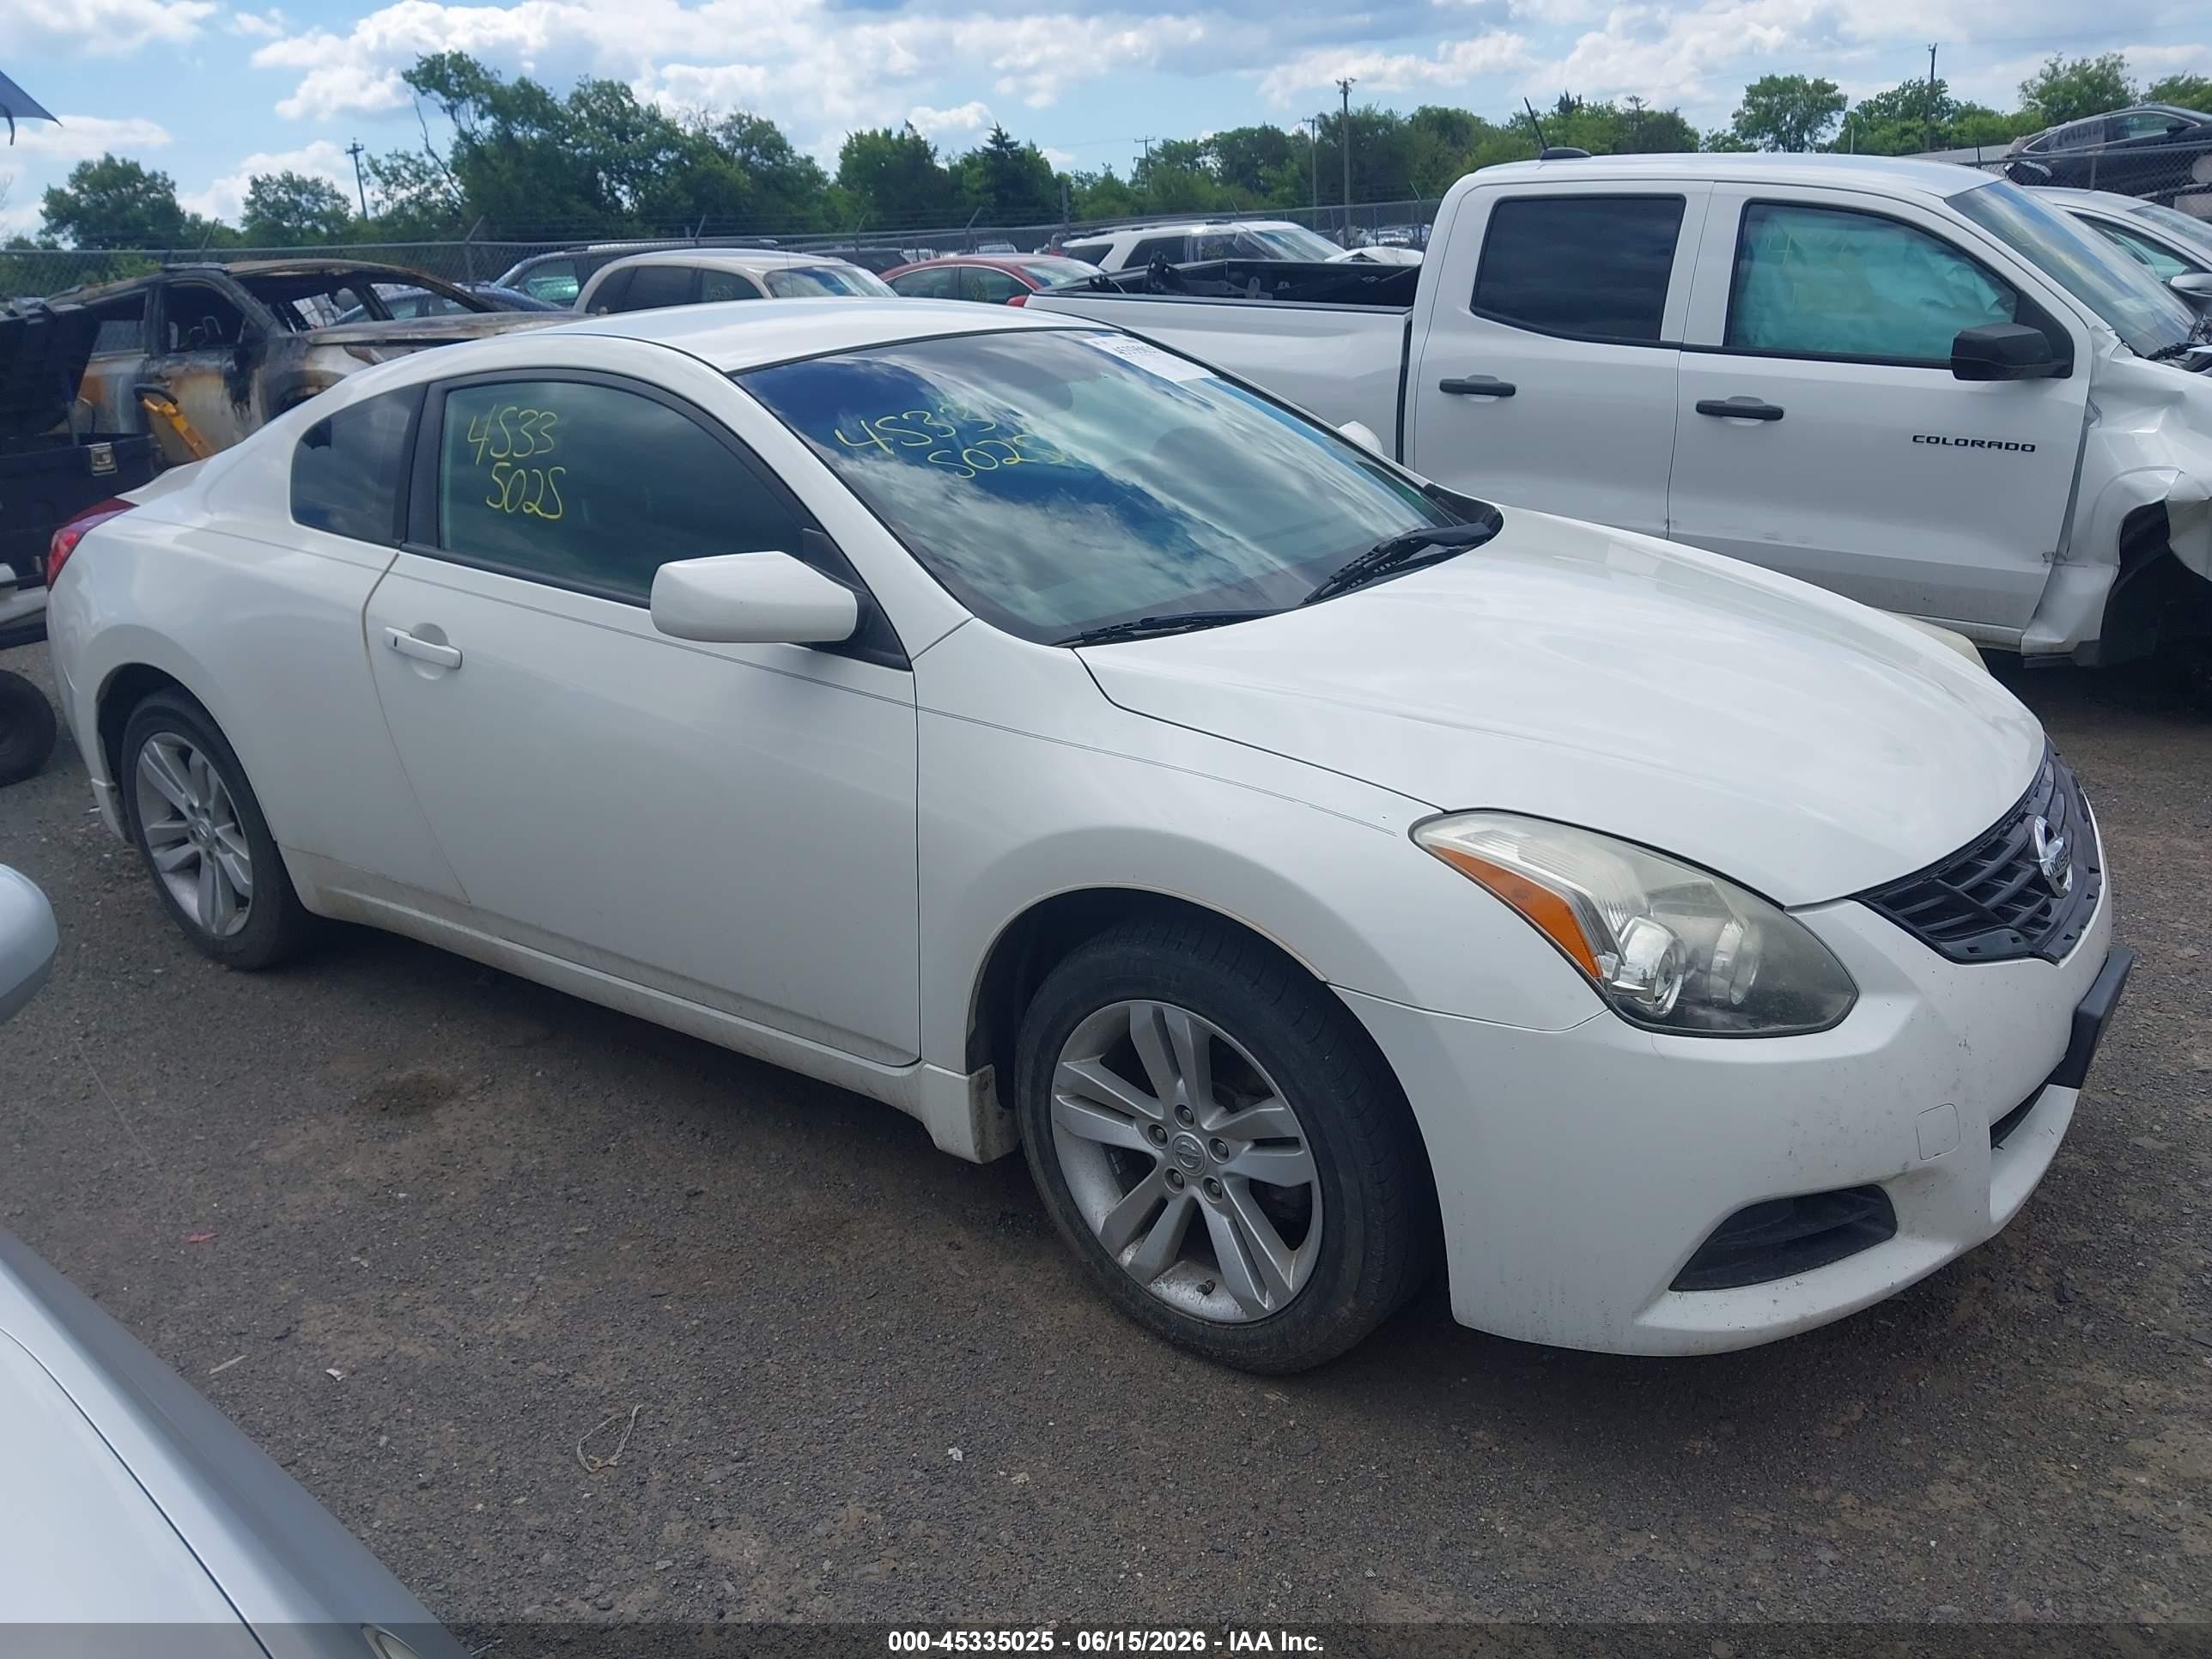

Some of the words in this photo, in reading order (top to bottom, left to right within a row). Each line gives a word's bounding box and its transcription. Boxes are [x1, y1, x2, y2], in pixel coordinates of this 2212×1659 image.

[466, 404, 558, 465] 4533
[834, 404, 996, 455] 4533
[1911, 434, 2036, 453] COLORADO
[927, 434, 1066, 478] 5025
[485, 462, 567, 520] 5025
